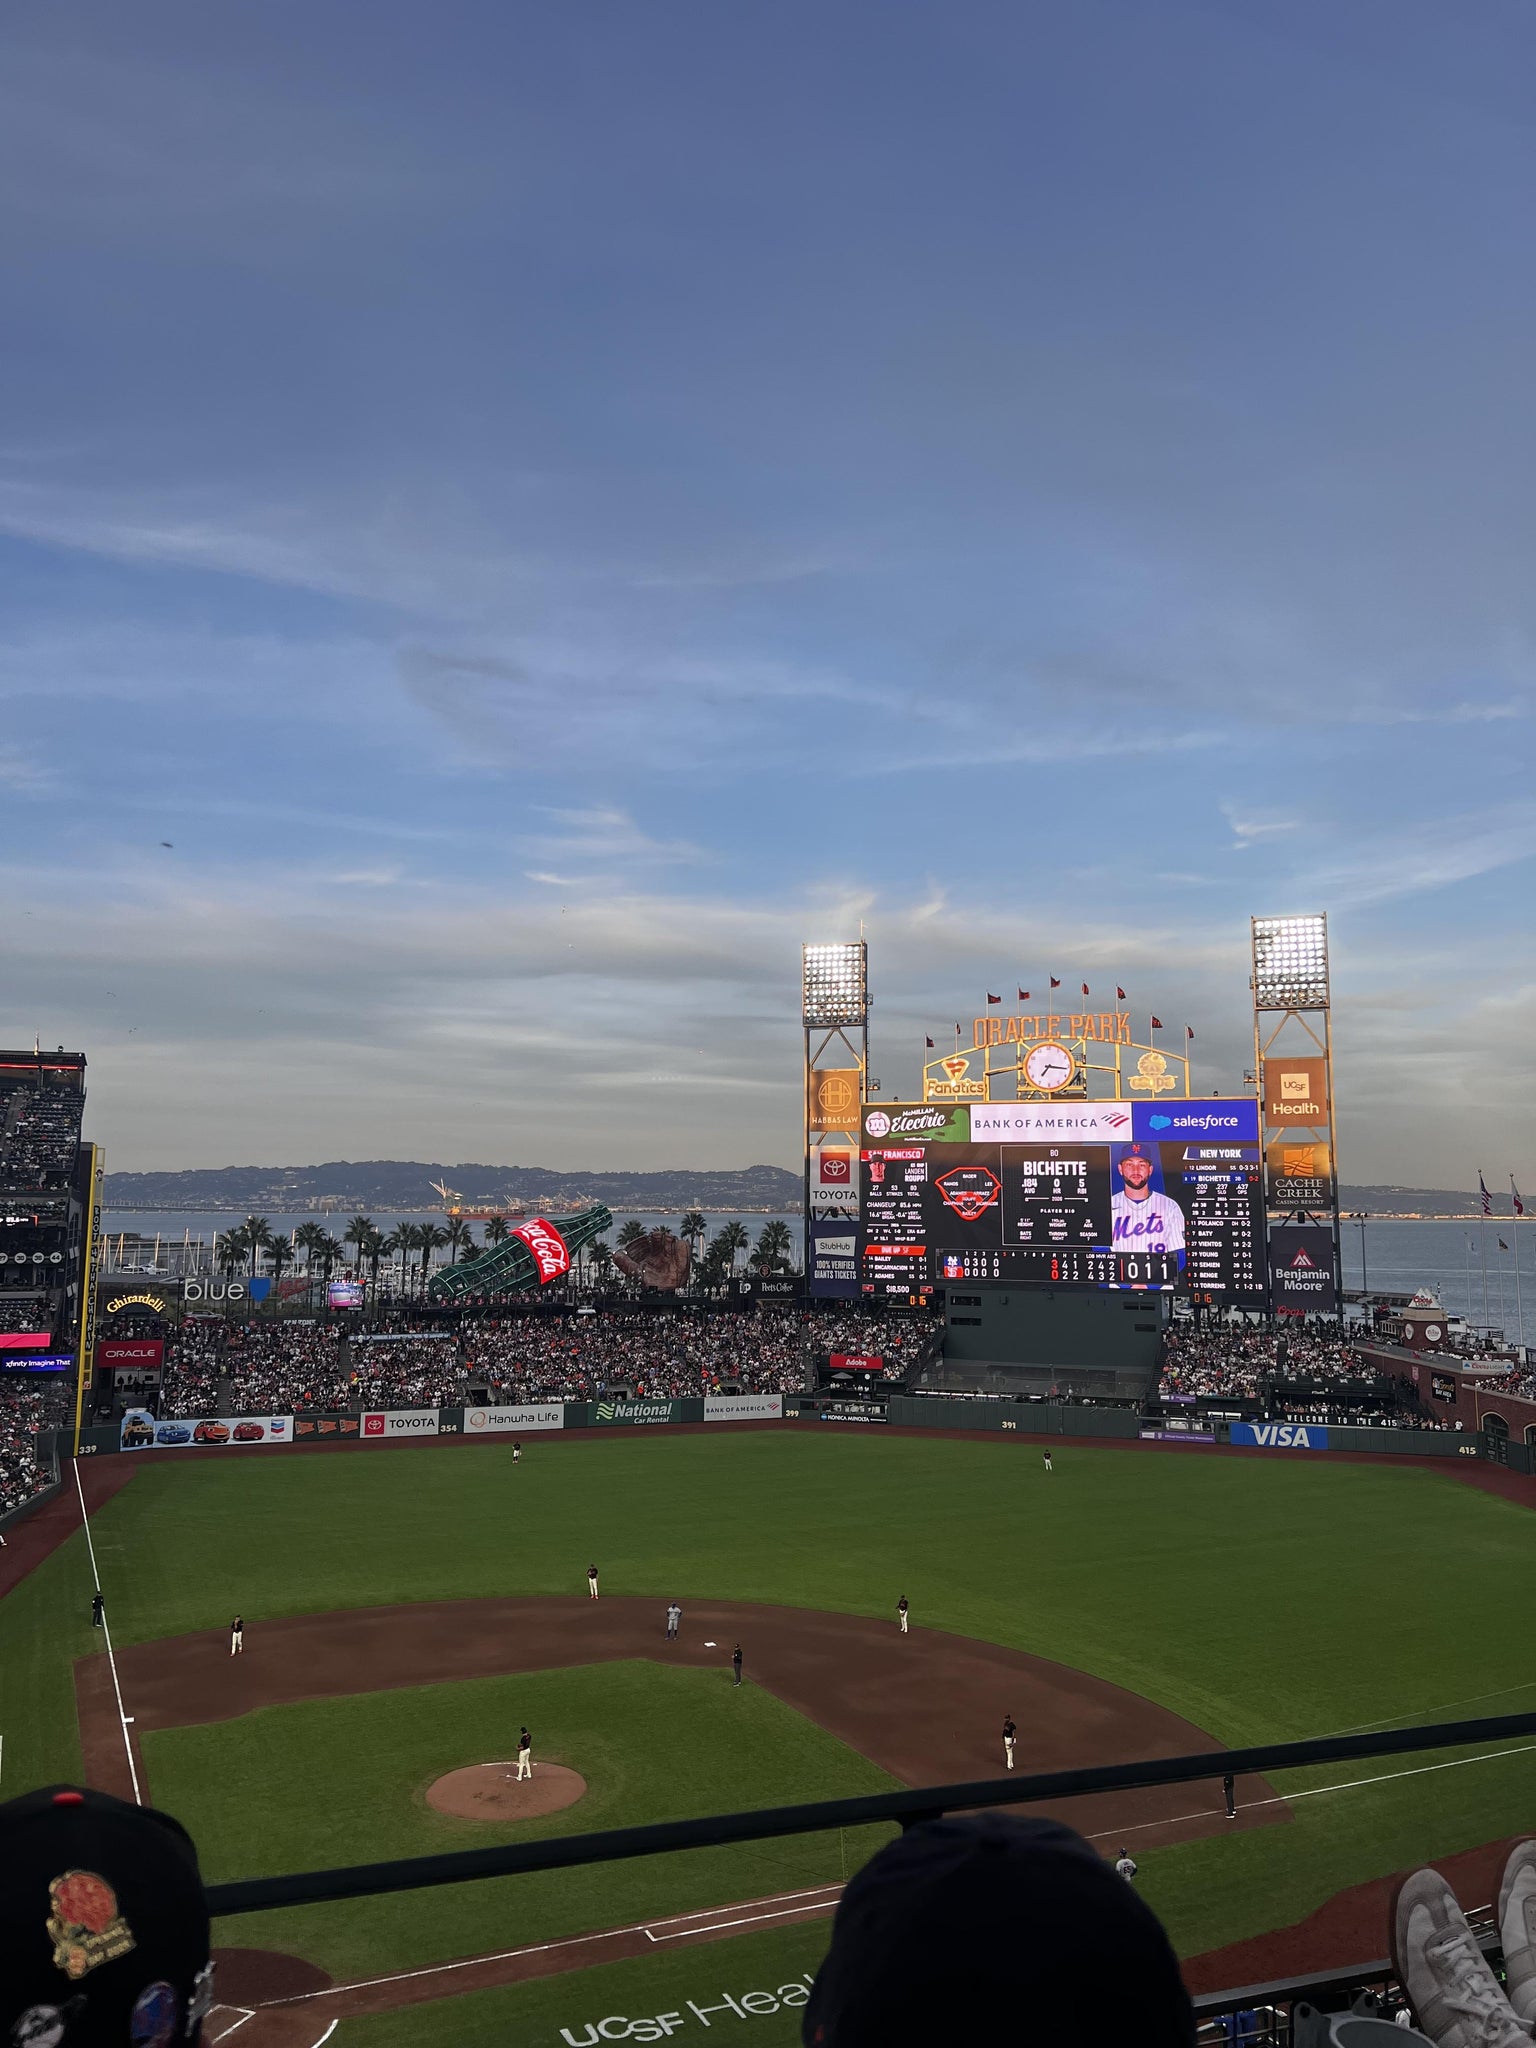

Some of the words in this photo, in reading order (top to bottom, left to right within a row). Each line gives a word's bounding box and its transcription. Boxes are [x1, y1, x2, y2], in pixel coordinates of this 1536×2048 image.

[973, 1016, 1061, 1048] ORACLE
[1070, 1013, 1131, 1045] PARK
[928, 1081, 984, 1095] Fanatics
[1284, 1081, 1306, 1092] UCSF
[1272, 1102, 1320, 1115] Health
[812, 1116, 841, 1124] HABBAS
[891, 1112, 946, 1132] Electric
[974, 1120, 1010, 1128] BANK
[1015, 1119, 1031, 1128] OF
[1035, 1118, 1098, 1128] AMERICA
[1173, 1114, 1238, 1130] salesforce
[884, 1150, 920, 1159] FRANCISCO
[1200, 1150, 1217, 1158] NEW
[1219, 1150, 1242, 1158] YORK
[1023, 1161, 1087, 1176] BICHETTE
[1022, 1178, 1038, 1188] .184
[1054, 1179, 1060, 1187] 0
[1079, 1179, 1085, 1187] 5
[1275, 1178, 1324, 1188] CACHE
[812, 1190, 858, 1200] TOYOTA
[1276, 1189, 1322, 1198] CREEK
[1112, 1213, 1164, 1241] Mets
[820, 1242, 850, 1250] StubHub
[816, 1260, 830, 1269] 100%
[831, 1261, 855, 1270] VERIFIED
[964, 1258, 970, 1267] 0
[973, 1258, 978, 1267] 3
[981, 1258, 987, 1267] 0
[993, 1259, 999, 1267] 0
[1051, 1260, 1058, 1269] 3
[1062, 1260, 1068, 1269] 4
[1073, 1261, 1077, 1269] 1
[1089, 1261, 1094, 1270] 2
[1098, 1261, 1104, 1270] 4
[1109, 1261, 1115, 1270] 2
[814, 1270, 834, 1279] GIANTS
[834, 1270, 856, 1280] TICKETS
[964, 1268, 970, 1277] 0
[973, 1268, 978, 1277] 0
[981, 1268, 987, 1277] 0
[994, 1269, 999, 1277] 0
[1051, 1271, 1058, 1279] 0
[1062, 1271, 1068, 1279] 2
[1073, 1271, 1078, 1280] 2
[1088, 1271, 1094, 1280] 4
[1099, 1271, 1104, 1280] 3
[1109, 1272, 1115, 1280] 2
[1127, 1262, 1138, 1279] 0
[1145, 1263, 1151, 1280] 1
[1161, 1263, 1167, 1280] 1
[1276, 1269, 1330, 1280] Benjamin
[184, 1278, 244, 1300] blue
[1284, 1280, 1322, 1291] Moore
[106, 1293, 166, 1313] Ghirardelli
[1276, 1305, 1305, 1317] Coors
[106, 1350, 155, 1358] ORACLE
[614, 1403, 672, 1417] National
[390, 1418, 435, 1429] TOYOTA
[489, 1413, 534, 1424] Hanwha
[537, 1412, 559, 1422] Life
[1287, 1415, 1328, 1423] WELCOME
[441, 1424, 457, 1432] 354
[1248, 1425, 1310, 1448] VISA
[79, 1445, 97, 1454] 339
[1459, 1447, 1476, 1455] 415
[560, 2012, 684, 2047] UCSF
